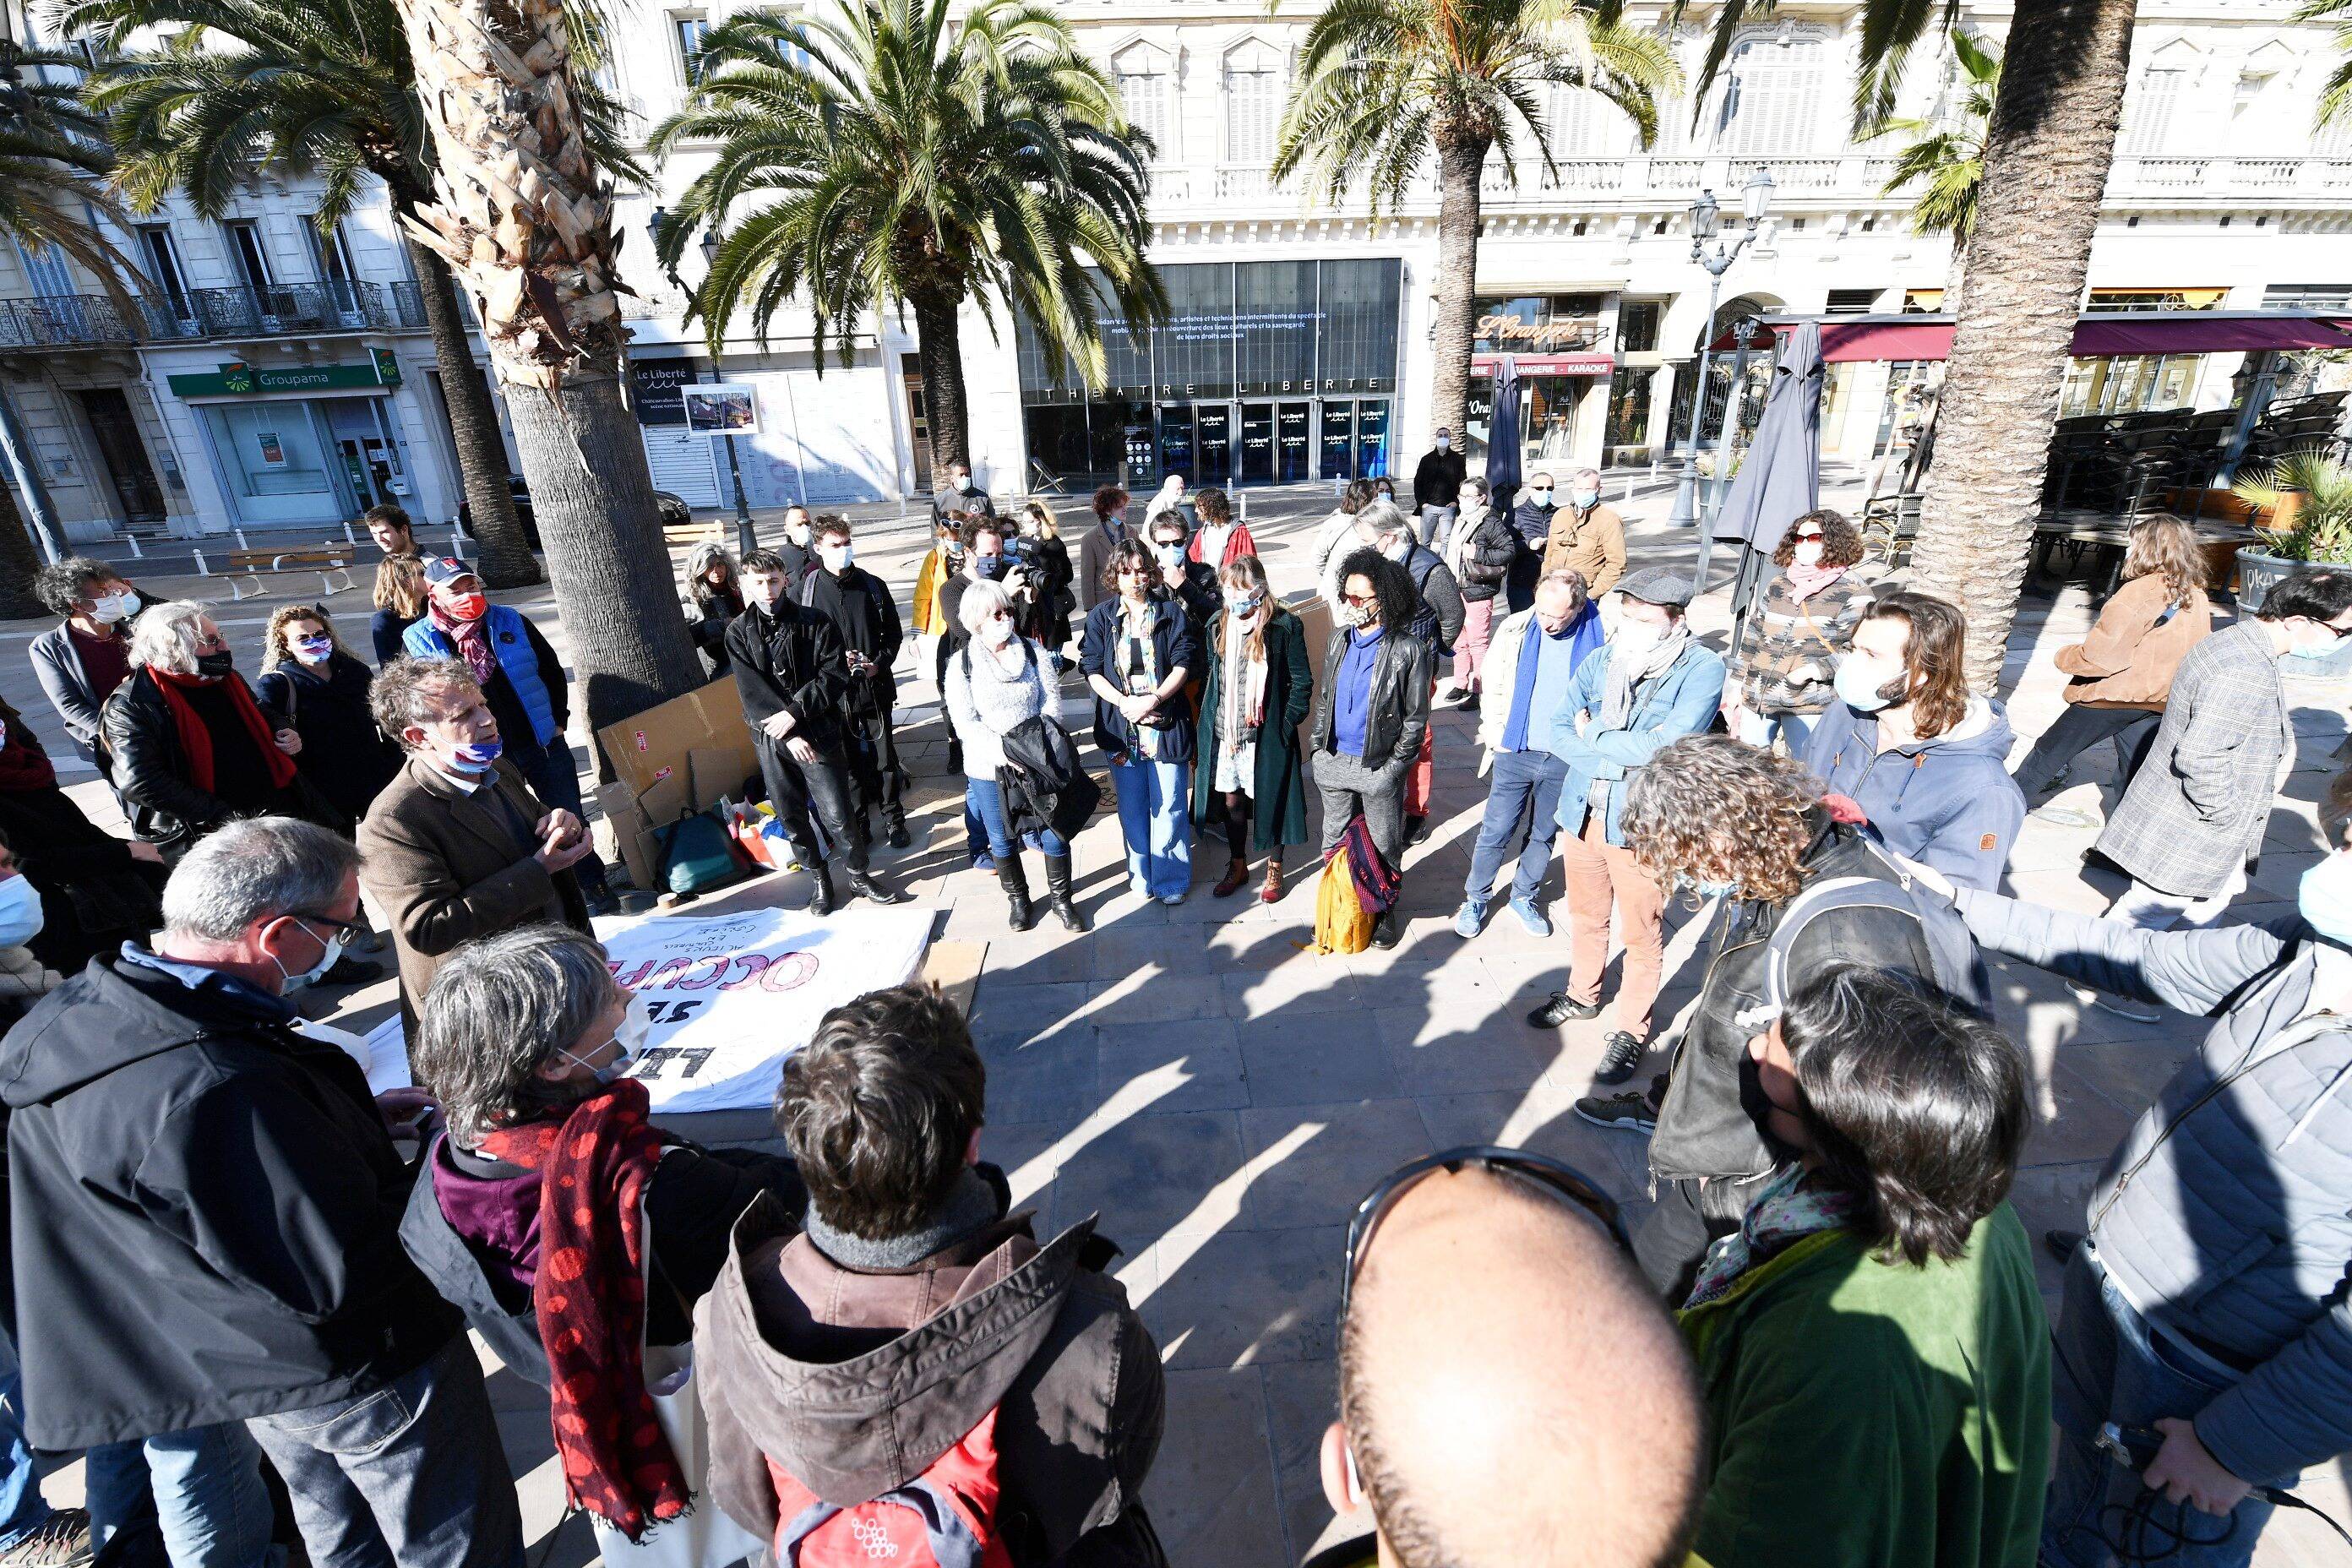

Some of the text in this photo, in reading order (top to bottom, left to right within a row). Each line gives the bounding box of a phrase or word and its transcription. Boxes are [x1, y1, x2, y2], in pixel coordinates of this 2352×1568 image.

[259, 373, 329, 387] Groupama
[637, 368, 687, 379] Le Liberté
[1044, 378, 1378, 400] THEATRE LIBERTE
